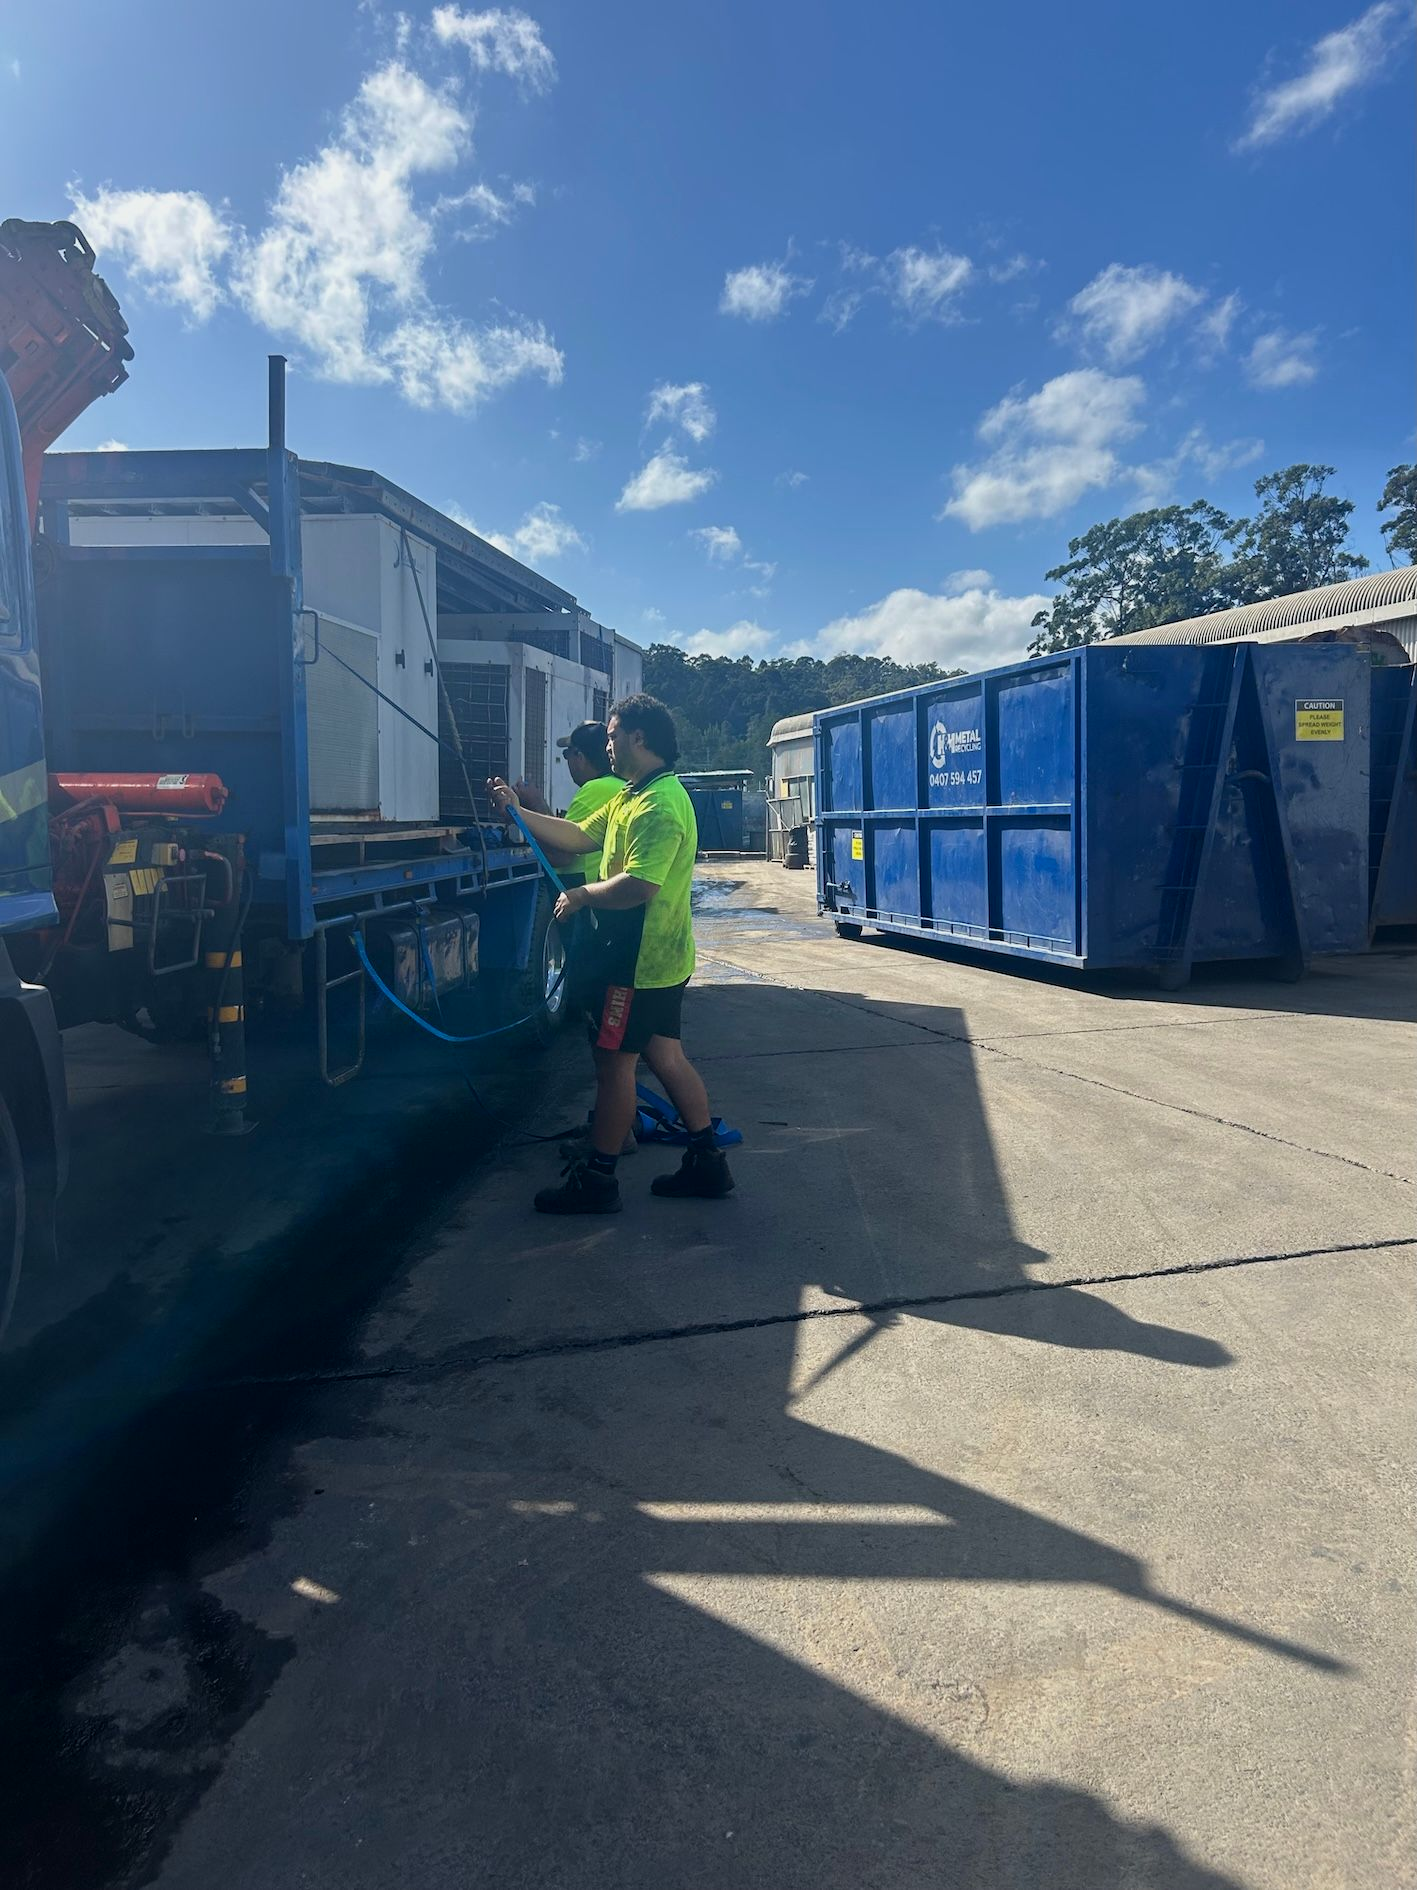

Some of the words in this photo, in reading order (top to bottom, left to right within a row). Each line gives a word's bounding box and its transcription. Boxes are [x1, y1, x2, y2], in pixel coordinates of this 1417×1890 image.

[1303, 702, 1336, 710] CAUTION
[955, 728, 981, 744] METAL
[955, 742, 982, 753] RECYCLING
[929, 772, 949, 787] 0407
[950, 771, 965, 786] 594
[966, 769, 982, 784] 457
